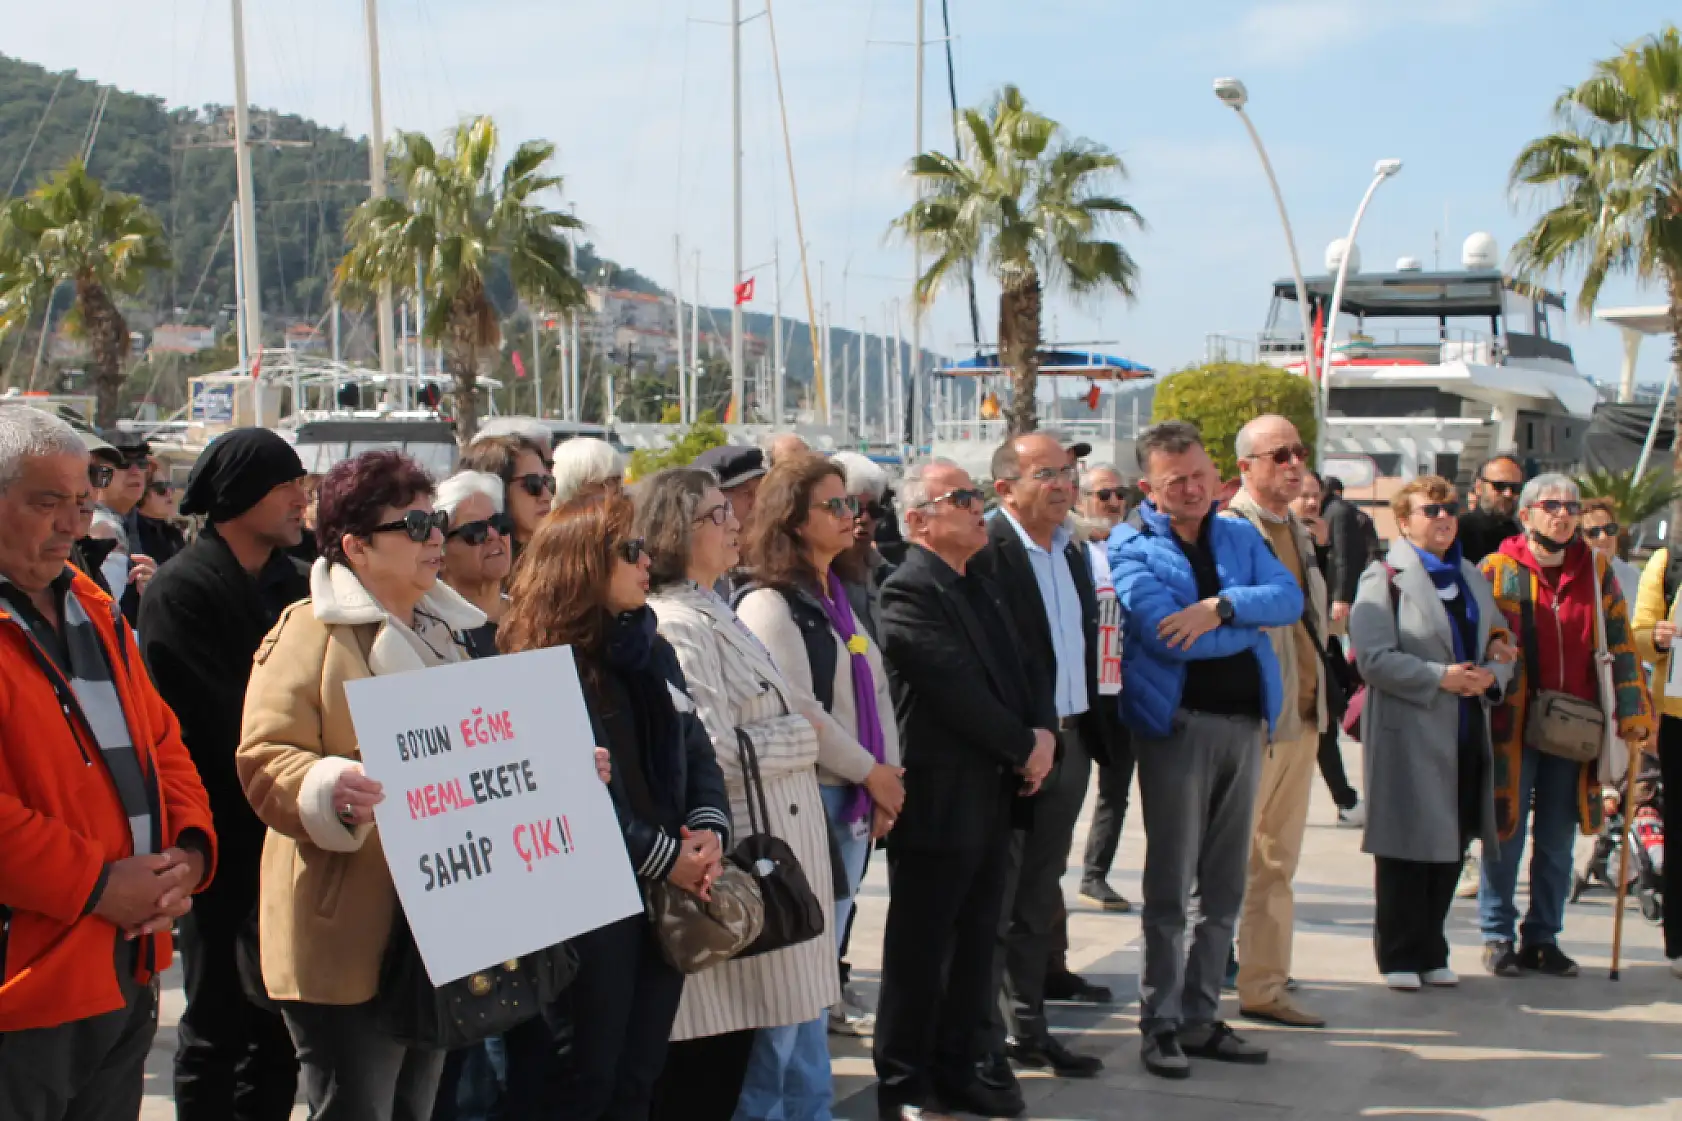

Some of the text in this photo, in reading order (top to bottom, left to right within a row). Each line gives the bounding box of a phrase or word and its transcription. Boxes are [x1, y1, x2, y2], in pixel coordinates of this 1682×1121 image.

[396, 707, 514, 761] BOYUN EĞME
[407, 760, 537, 819] MEMLEKETE
[419, 814, 574, 891] SAHİP ÇIK!!
